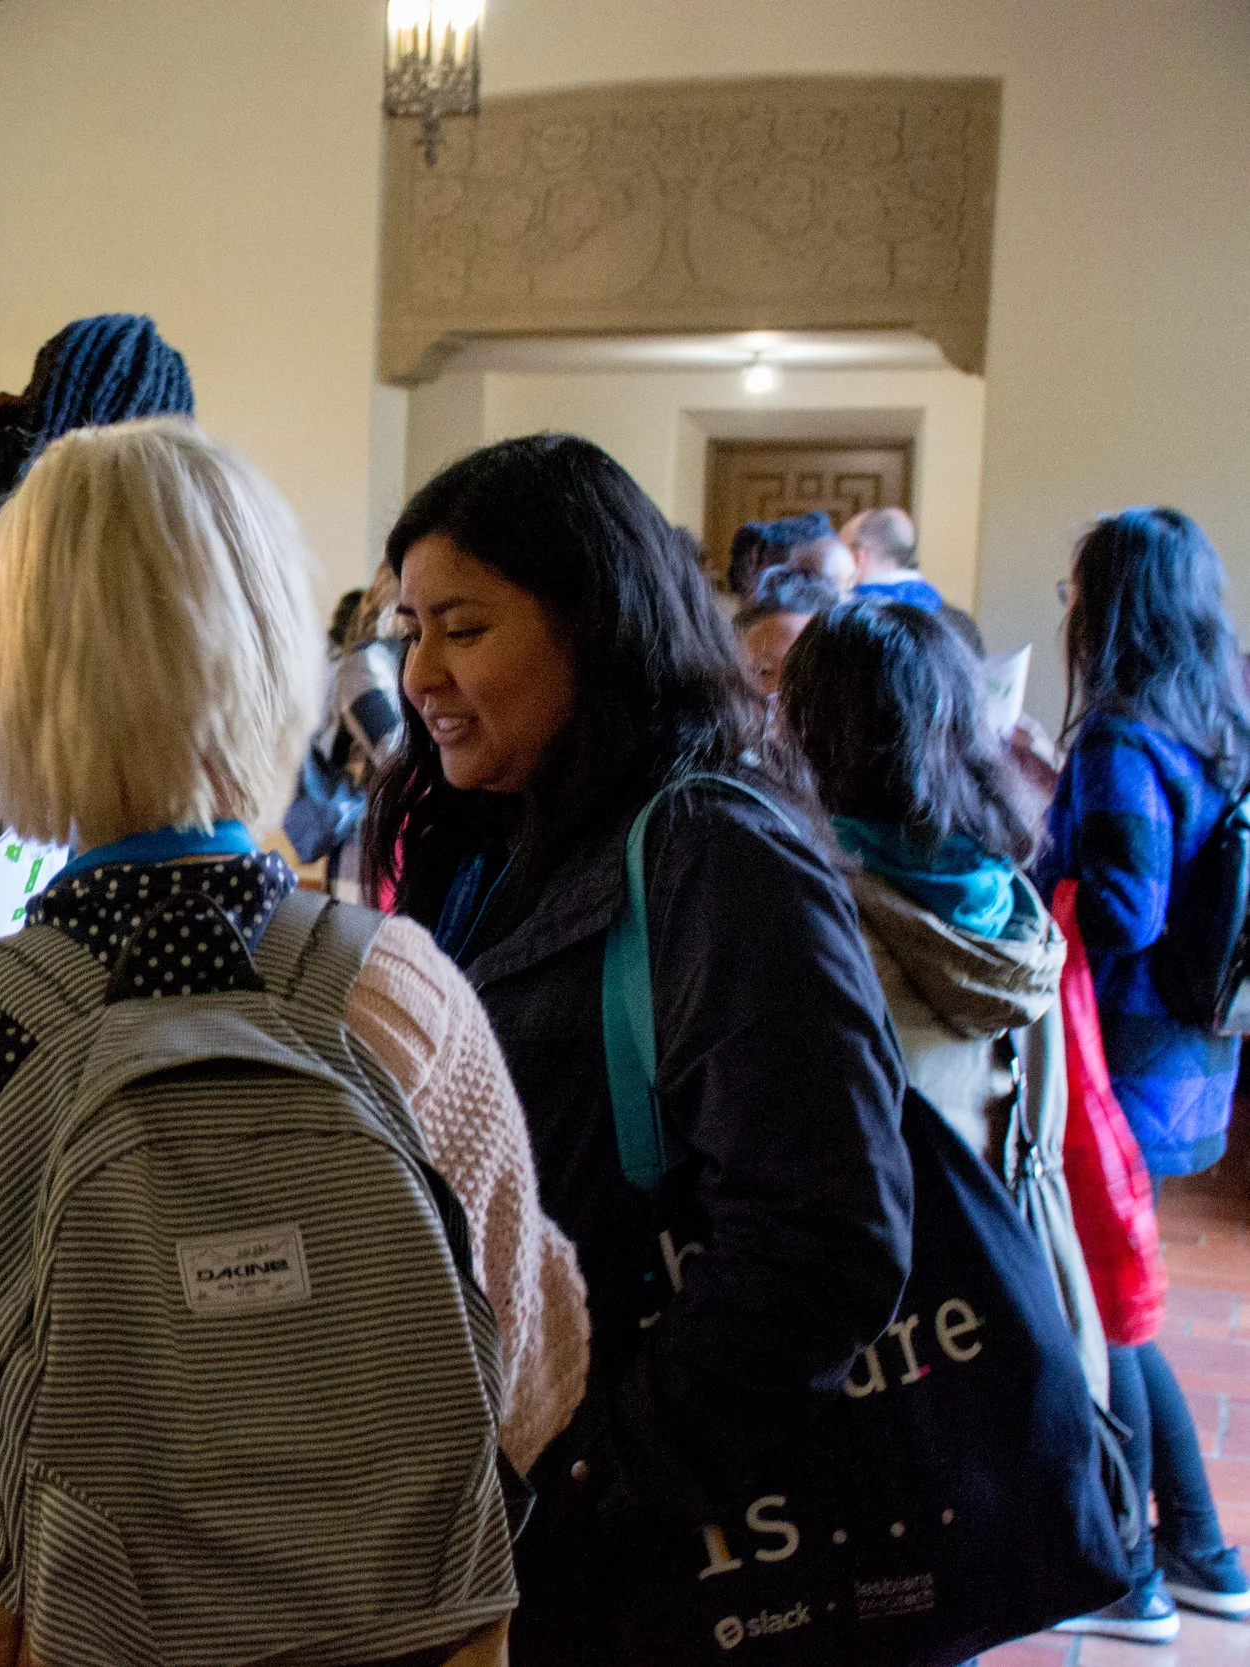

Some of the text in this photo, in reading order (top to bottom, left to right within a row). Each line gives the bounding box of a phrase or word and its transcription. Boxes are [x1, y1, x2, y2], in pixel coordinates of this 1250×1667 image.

[196, 1258, 290, 1283] DAKINE
[845, 1298, 984, 1398] ure
[746, 1602, 811, 1637] slack
